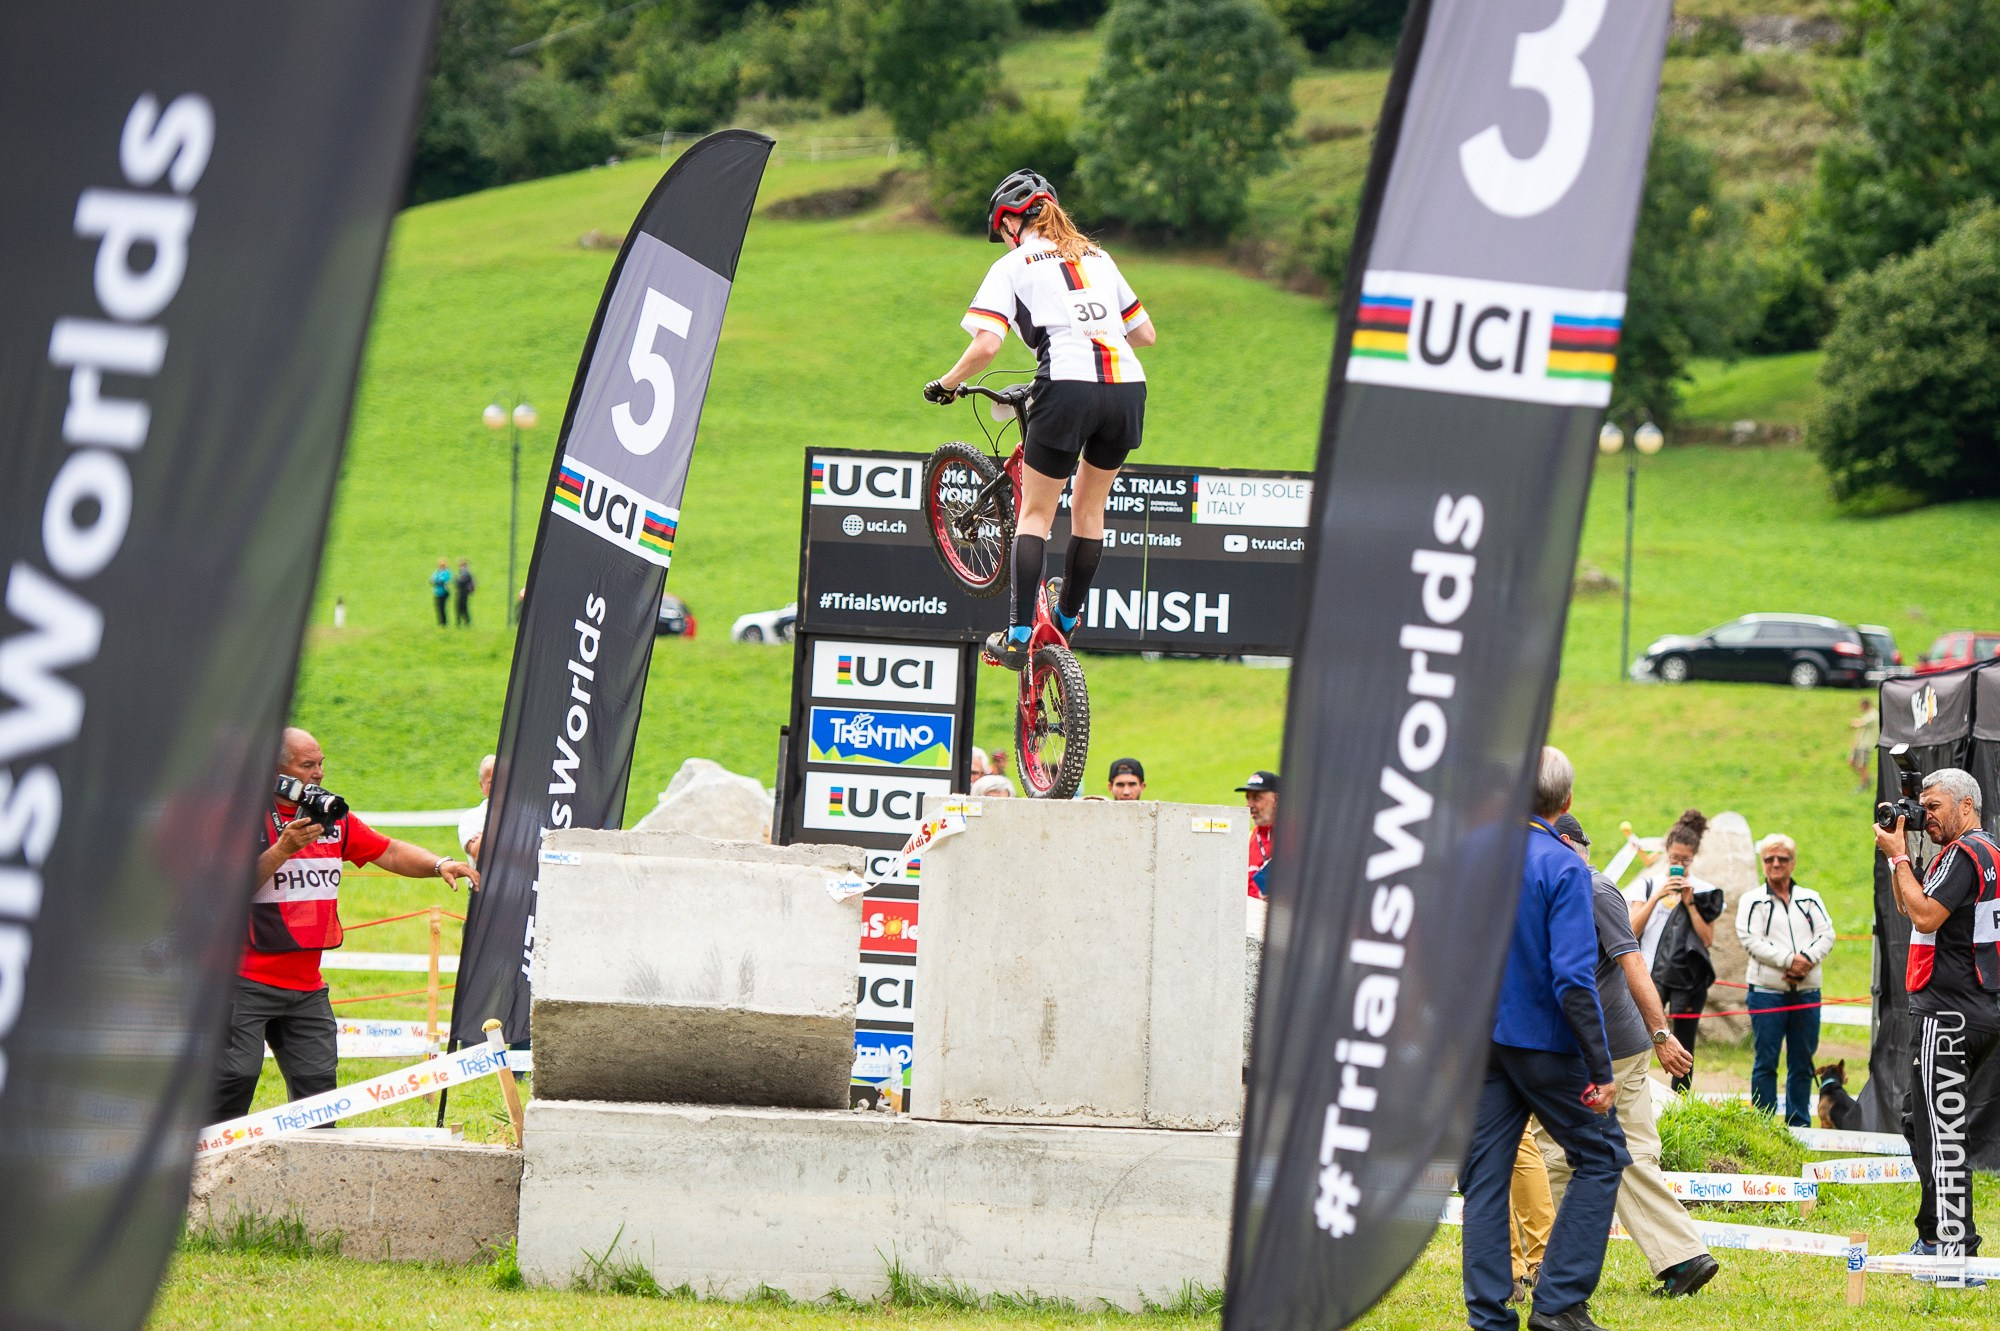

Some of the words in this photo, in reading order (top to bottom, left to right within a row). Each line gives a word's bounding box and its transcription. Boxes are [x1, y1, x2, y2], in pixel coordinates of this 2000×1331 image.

[1459, 0, 1606, 217] 3
[1074, 302, 1108, 322] 3D
[1418, 301, 1530, 374] UCI
[610, 287, 693, 455] 5
[829, 464, 912, 498] UCI
[941, 468, 967, 485] 016
[1113, 477, 1126, 492] &
[1129, 478, 1187, 495] TRIALS
[1207, 482, 1236, 497] VAL
[1241, 483, 1256, 497] DI
[1262, 484, 1305, 499] SOLE
[584, 479, 637, 540] UCI
[1207, 500, 1245, 515] ITALY
[867, 519, 907, 534] uci.ch
[1251, 536, 1305, 551] tv.uci.ch
[820, 591, 947, 615] #TrialsWorlds
[1078, 588, 1230, 633] INISH
[856, 656, 934, 689] UCI
[830, 717, 934, 750] TRENTINO
[848, 787, 926, 820] UCI
[274, 868, 341, 890] PHOTO
[865, 855, 899, 878] CI
[1314, 494, 1483, 1238] #TrialsWorlds
[197, 1138, 209, 1153] al
[273, 1098, 351, 1131] TRENTINO
[367, 1083, 394, 1102] Val
[397, 1082, 409, 1095] di
[408, 1068, 449, 1092] Sole
[457, 1050, 508, 1077] TRENT
[1690, 1180, 1732, 1198] TRENTINO
[1743, 1180, 1756, 1196] Val
[1794, 1182, 1819, 1198] TRENT
